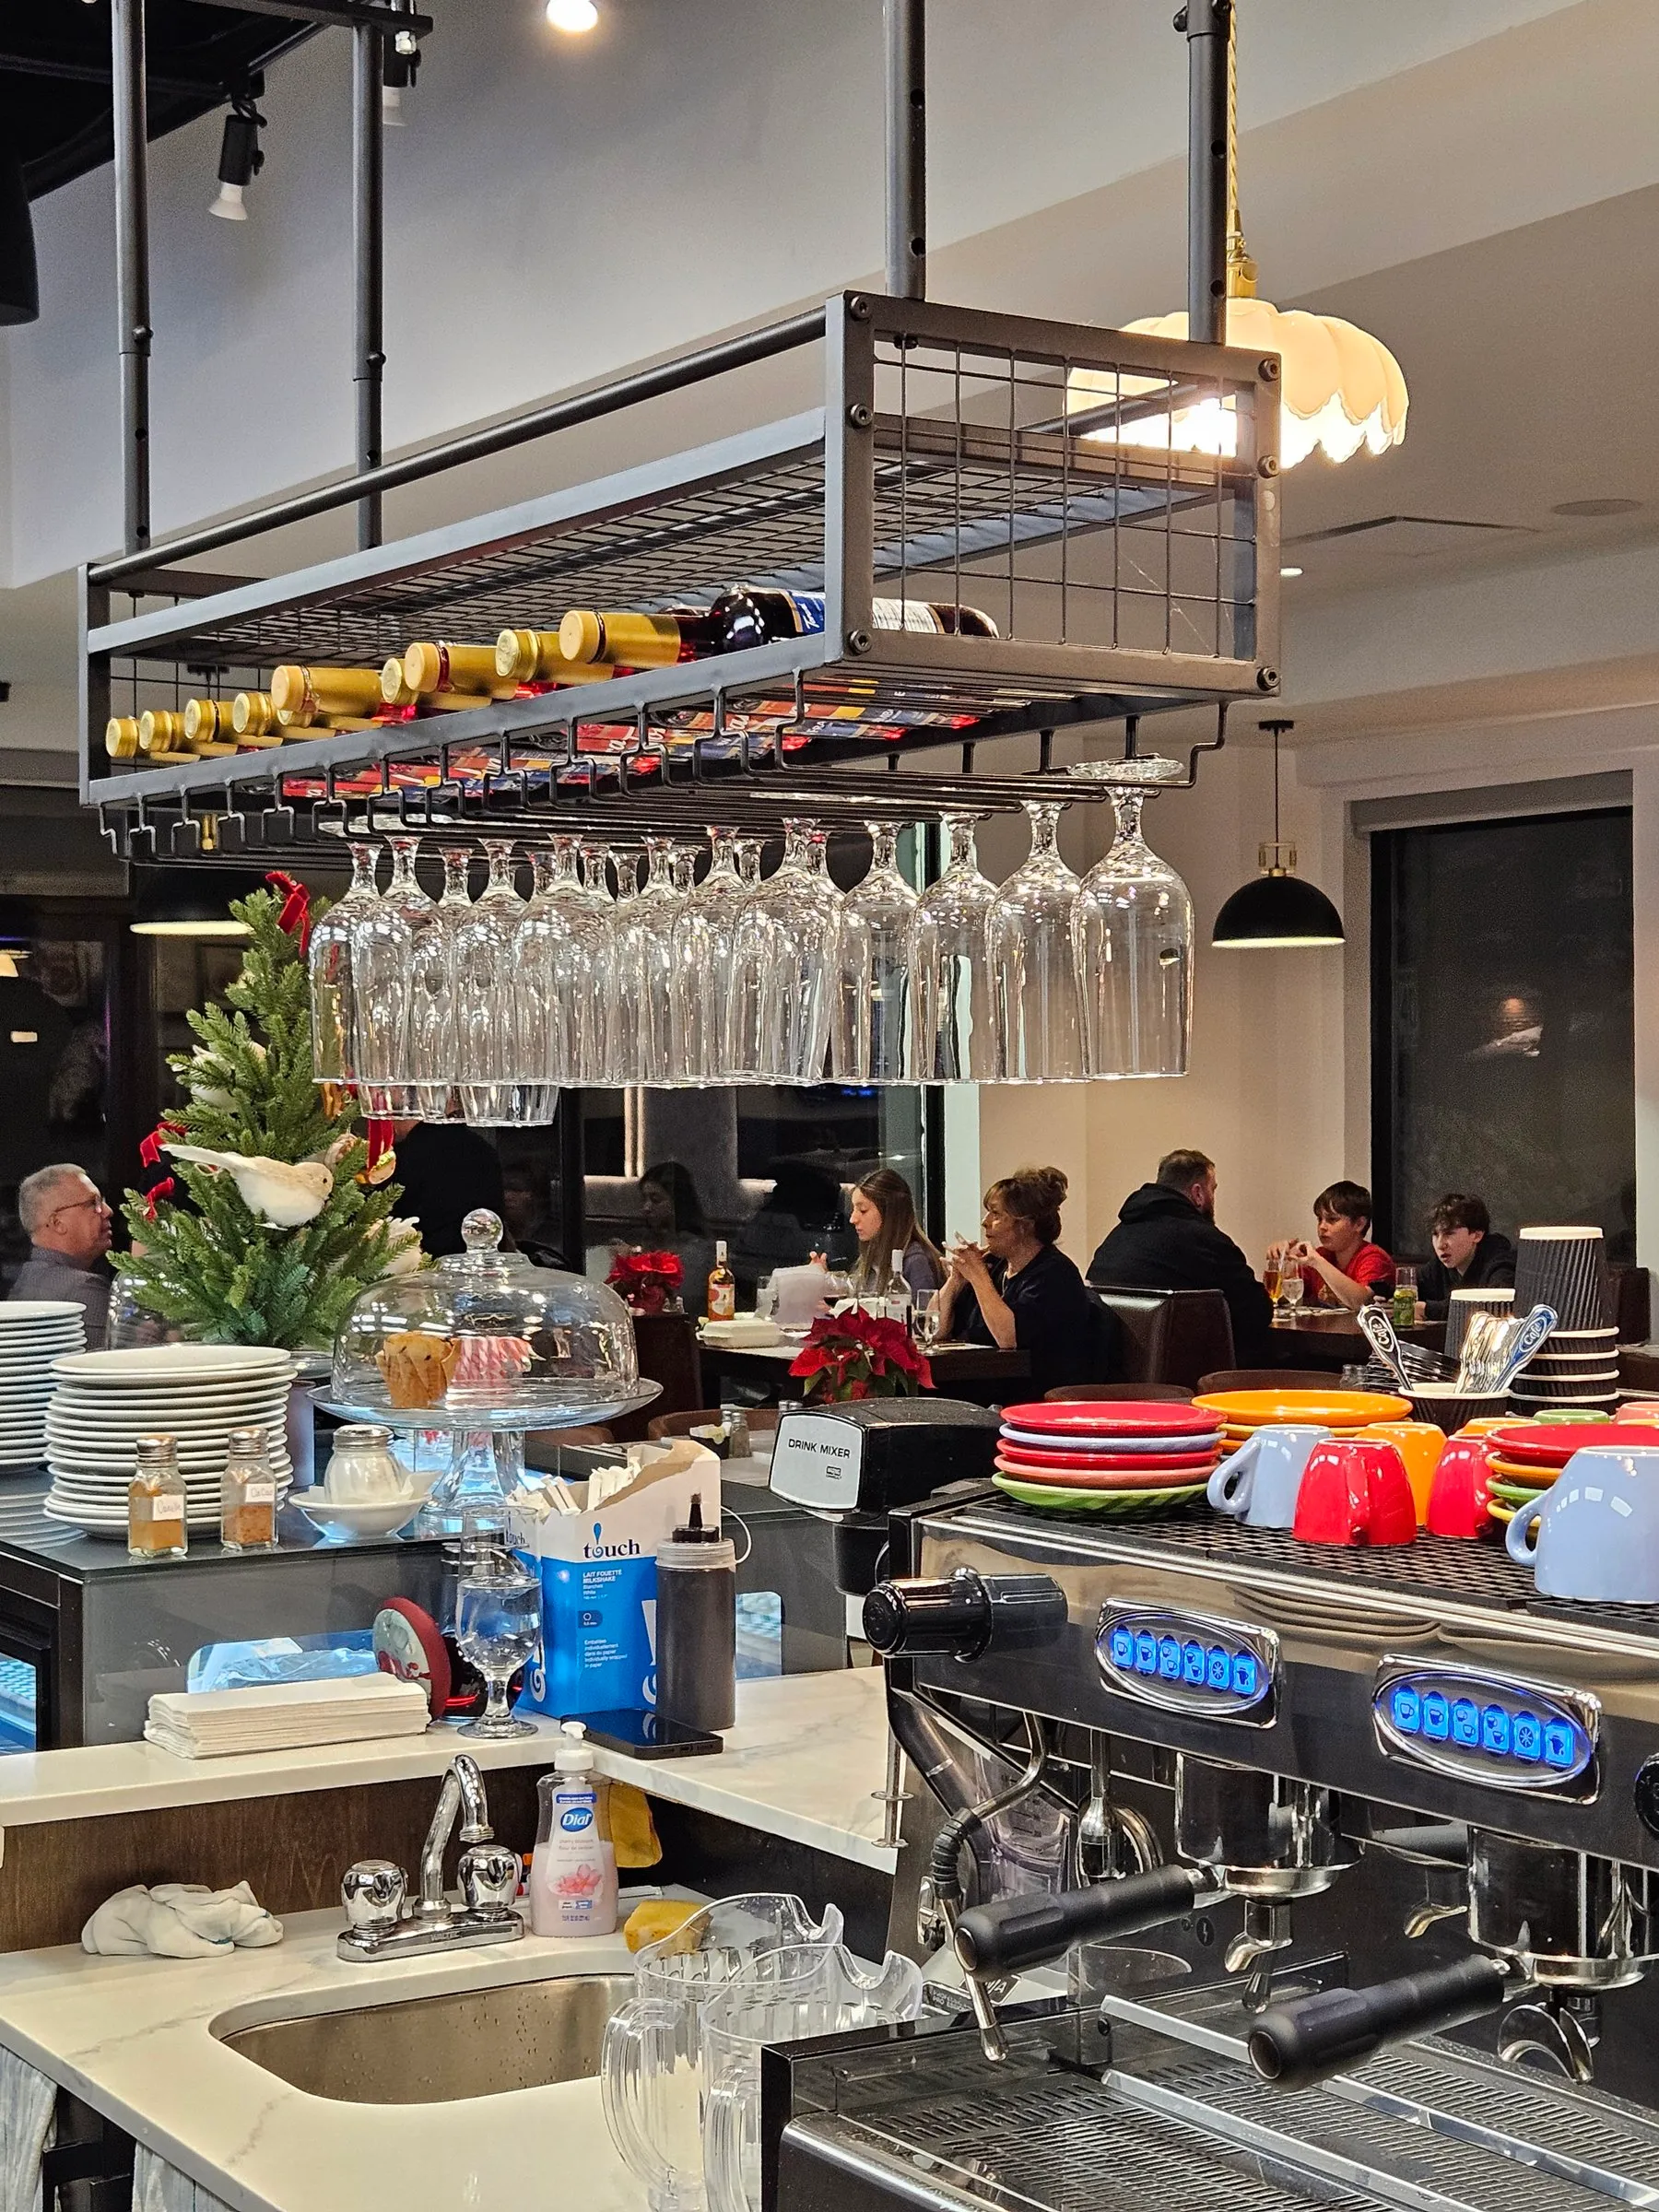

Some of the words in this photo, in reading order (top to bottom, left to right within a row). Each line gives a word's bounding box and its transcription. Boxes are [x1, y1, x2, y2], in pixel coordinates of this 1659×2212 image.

[788, 1438, 818, 1453] DRINK
[819, 1444, 851, 1459] MIXER
[583, 1538, 641, 1559] touch
[562, 1813, 592, 1826] Dial
